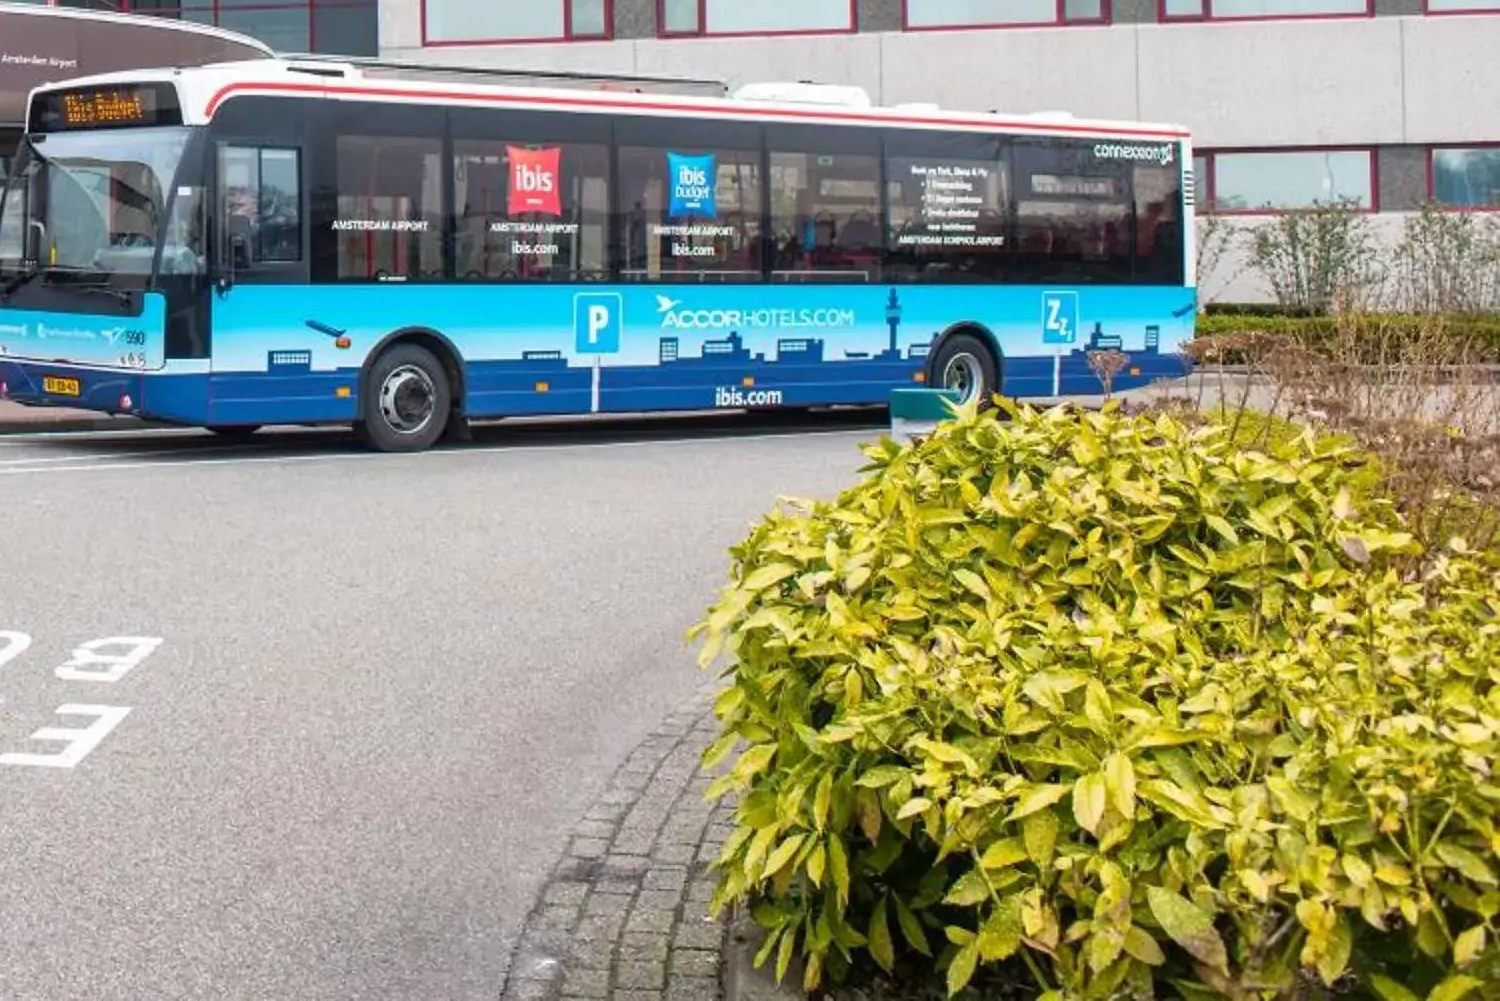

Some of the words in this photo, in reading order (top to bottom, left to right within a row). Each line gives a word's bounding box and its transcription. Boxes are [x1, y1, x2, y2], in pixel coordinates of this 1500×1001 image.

[1, 52, 47, 65] Amsterdam
[49, 55, 77, 69] Airport
[515, 163, 554, 192] ibis
[679, 165, 706, 186] ibis
[676, 184, 710, 202] budget
[332, 220, 390, 230] AMSTERDAM
[391, 221, 428, 232] AIRPORT
[490, 222, 543, 232] AMSTERDAM
[545, 224, 579, 234] AIRPORT
[653, 225, 700, 235] AMSTERDAM
[701, 226, 734, 236] AIRPORT
[511, 240, 559, 254] ibis.com
[671, 242, 716, 256] ibis.com
[588, 304, 609, 344] P
[661, 308, 855, 329] ACCORHOTELS.COM
[714, 386, 784, 407] ibis.com
